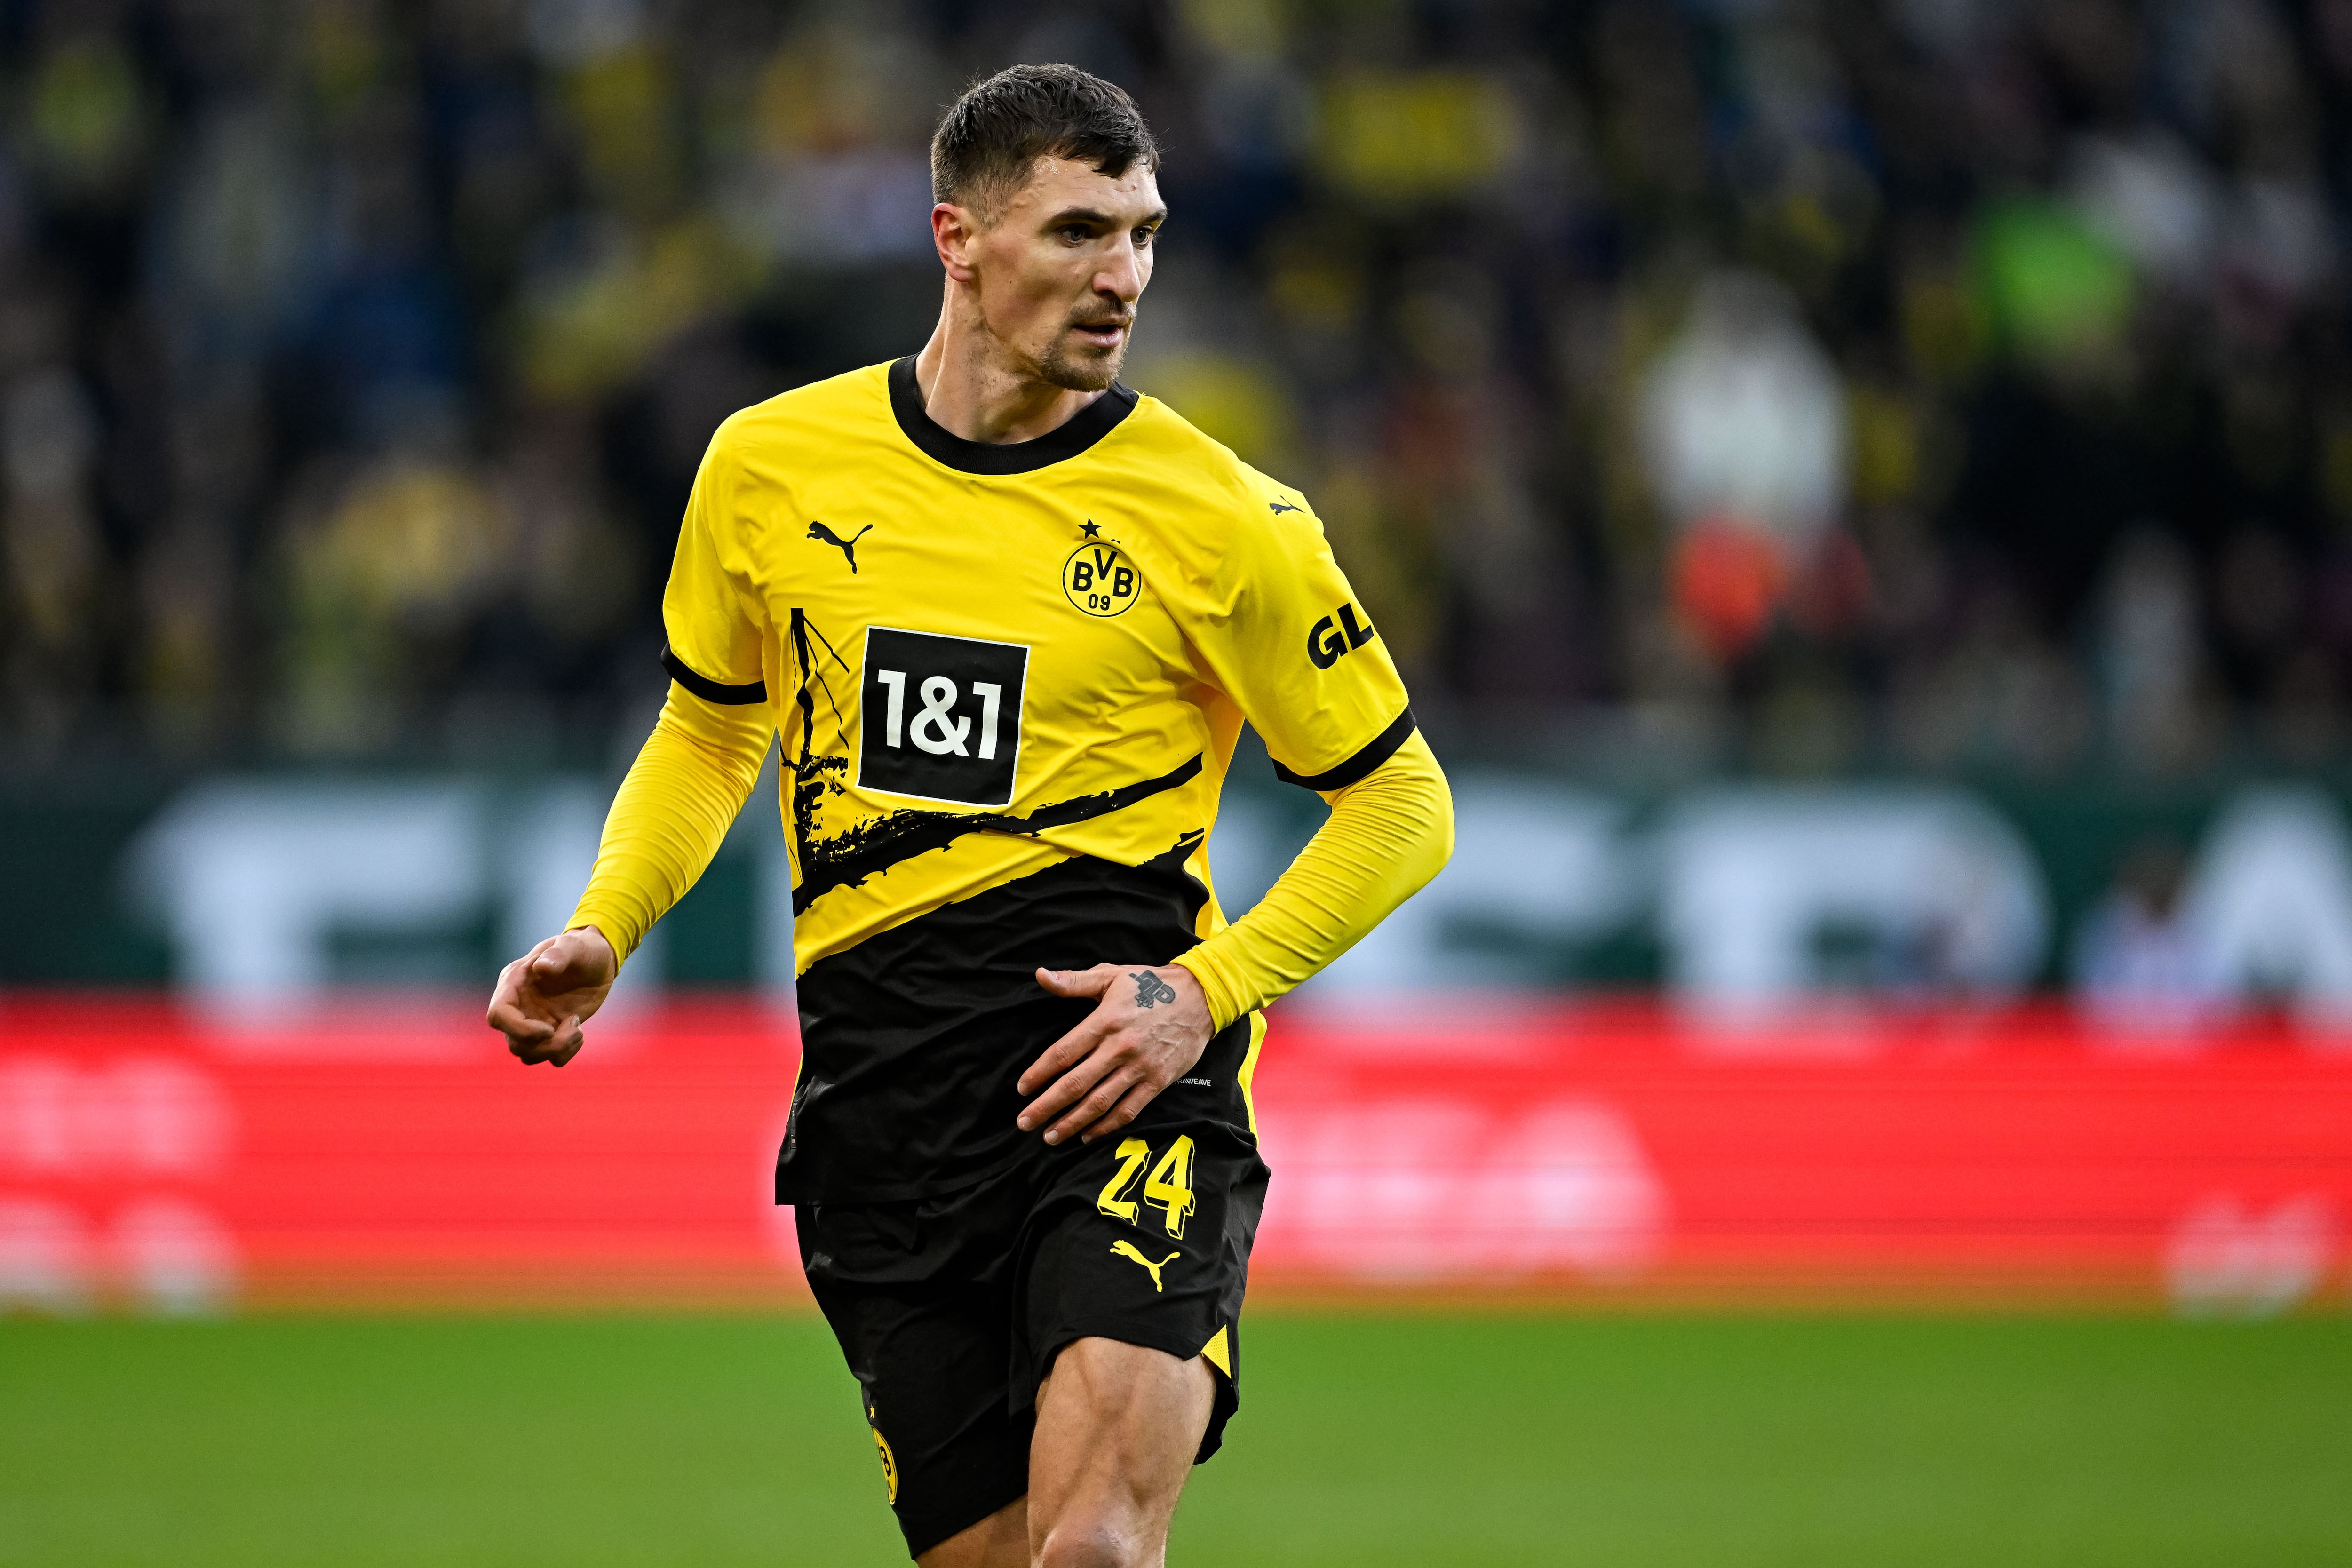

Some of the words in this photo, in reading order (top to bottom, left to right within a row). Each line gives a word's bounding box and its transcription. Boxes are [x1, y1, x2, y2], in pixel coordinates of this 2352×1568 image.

[1073, 548, 1134, 597] BVB
[1088, 593, 1111, 611] 09
[877, 669, 1001, 760] 1&1
[1175, 1078, 1211, 1087] RAWEAVE
[1097, 1134, 1196, 1240] 24
